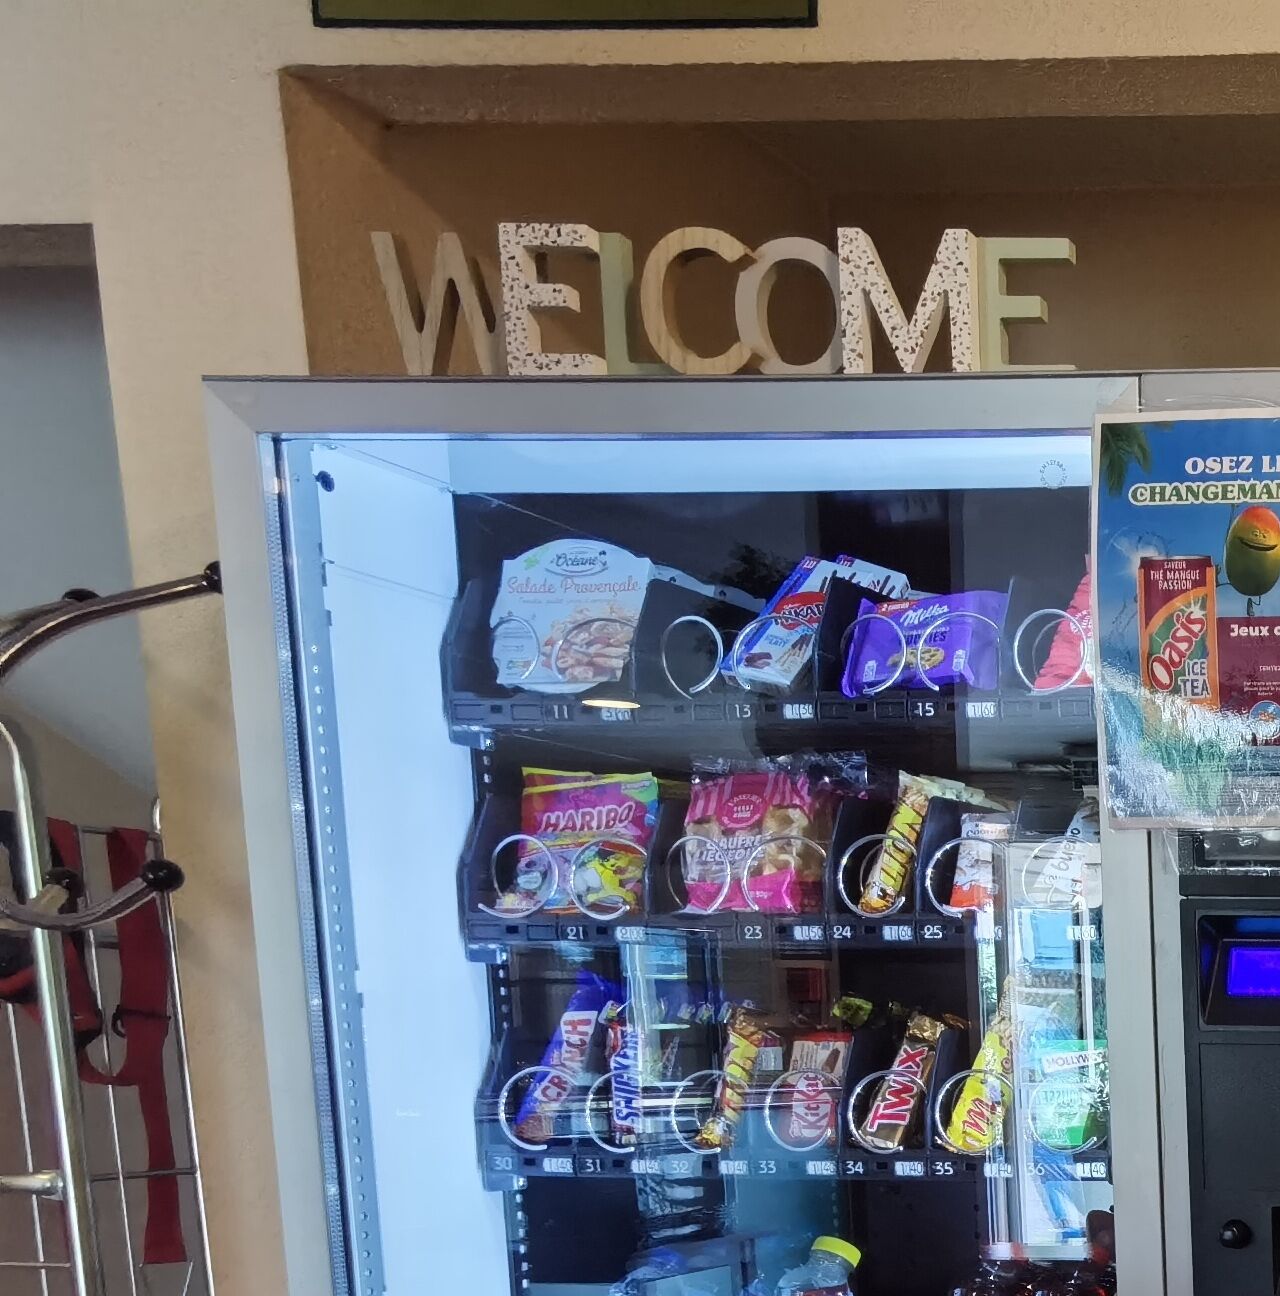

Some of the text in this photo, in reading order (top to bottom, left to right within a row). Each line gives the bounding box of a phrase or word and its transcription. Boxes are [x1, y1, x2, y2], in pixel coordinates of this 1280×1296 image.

[371, 223, 1077, 376] WELCOME
[1185, 456, 1253, 475] OSEZ
[1164, 561, 1186, 569] SAVEUR
[1167, 569, 1200, 580] MANGUE
[506, 575, 641, 598] Salade Provençale
[1159, 580, 1191, 590] PASSION
[900, 604, 950, 626] Milka
[1230, 624, 1269, 637] Jeux
[1149, 611, 1206, 692] Oasis
[1187, 660, 1207, 676] ICE
[1179, 678, 1209, 697] TEA
[917, 702, 935, 717] 15
[542, 801, 636, 833] HARIBO
[833, 925, 851, 939] 24
[924, 925, 943, 939] 25
[868, 1045, 928, 1132] TWIX
[586, 1156, 602, 1171] 31
[758, 1159, 777, 1174] 33
[845, 1160, 864, 1175] 34
[934, 1161, 954, 1175] 35
